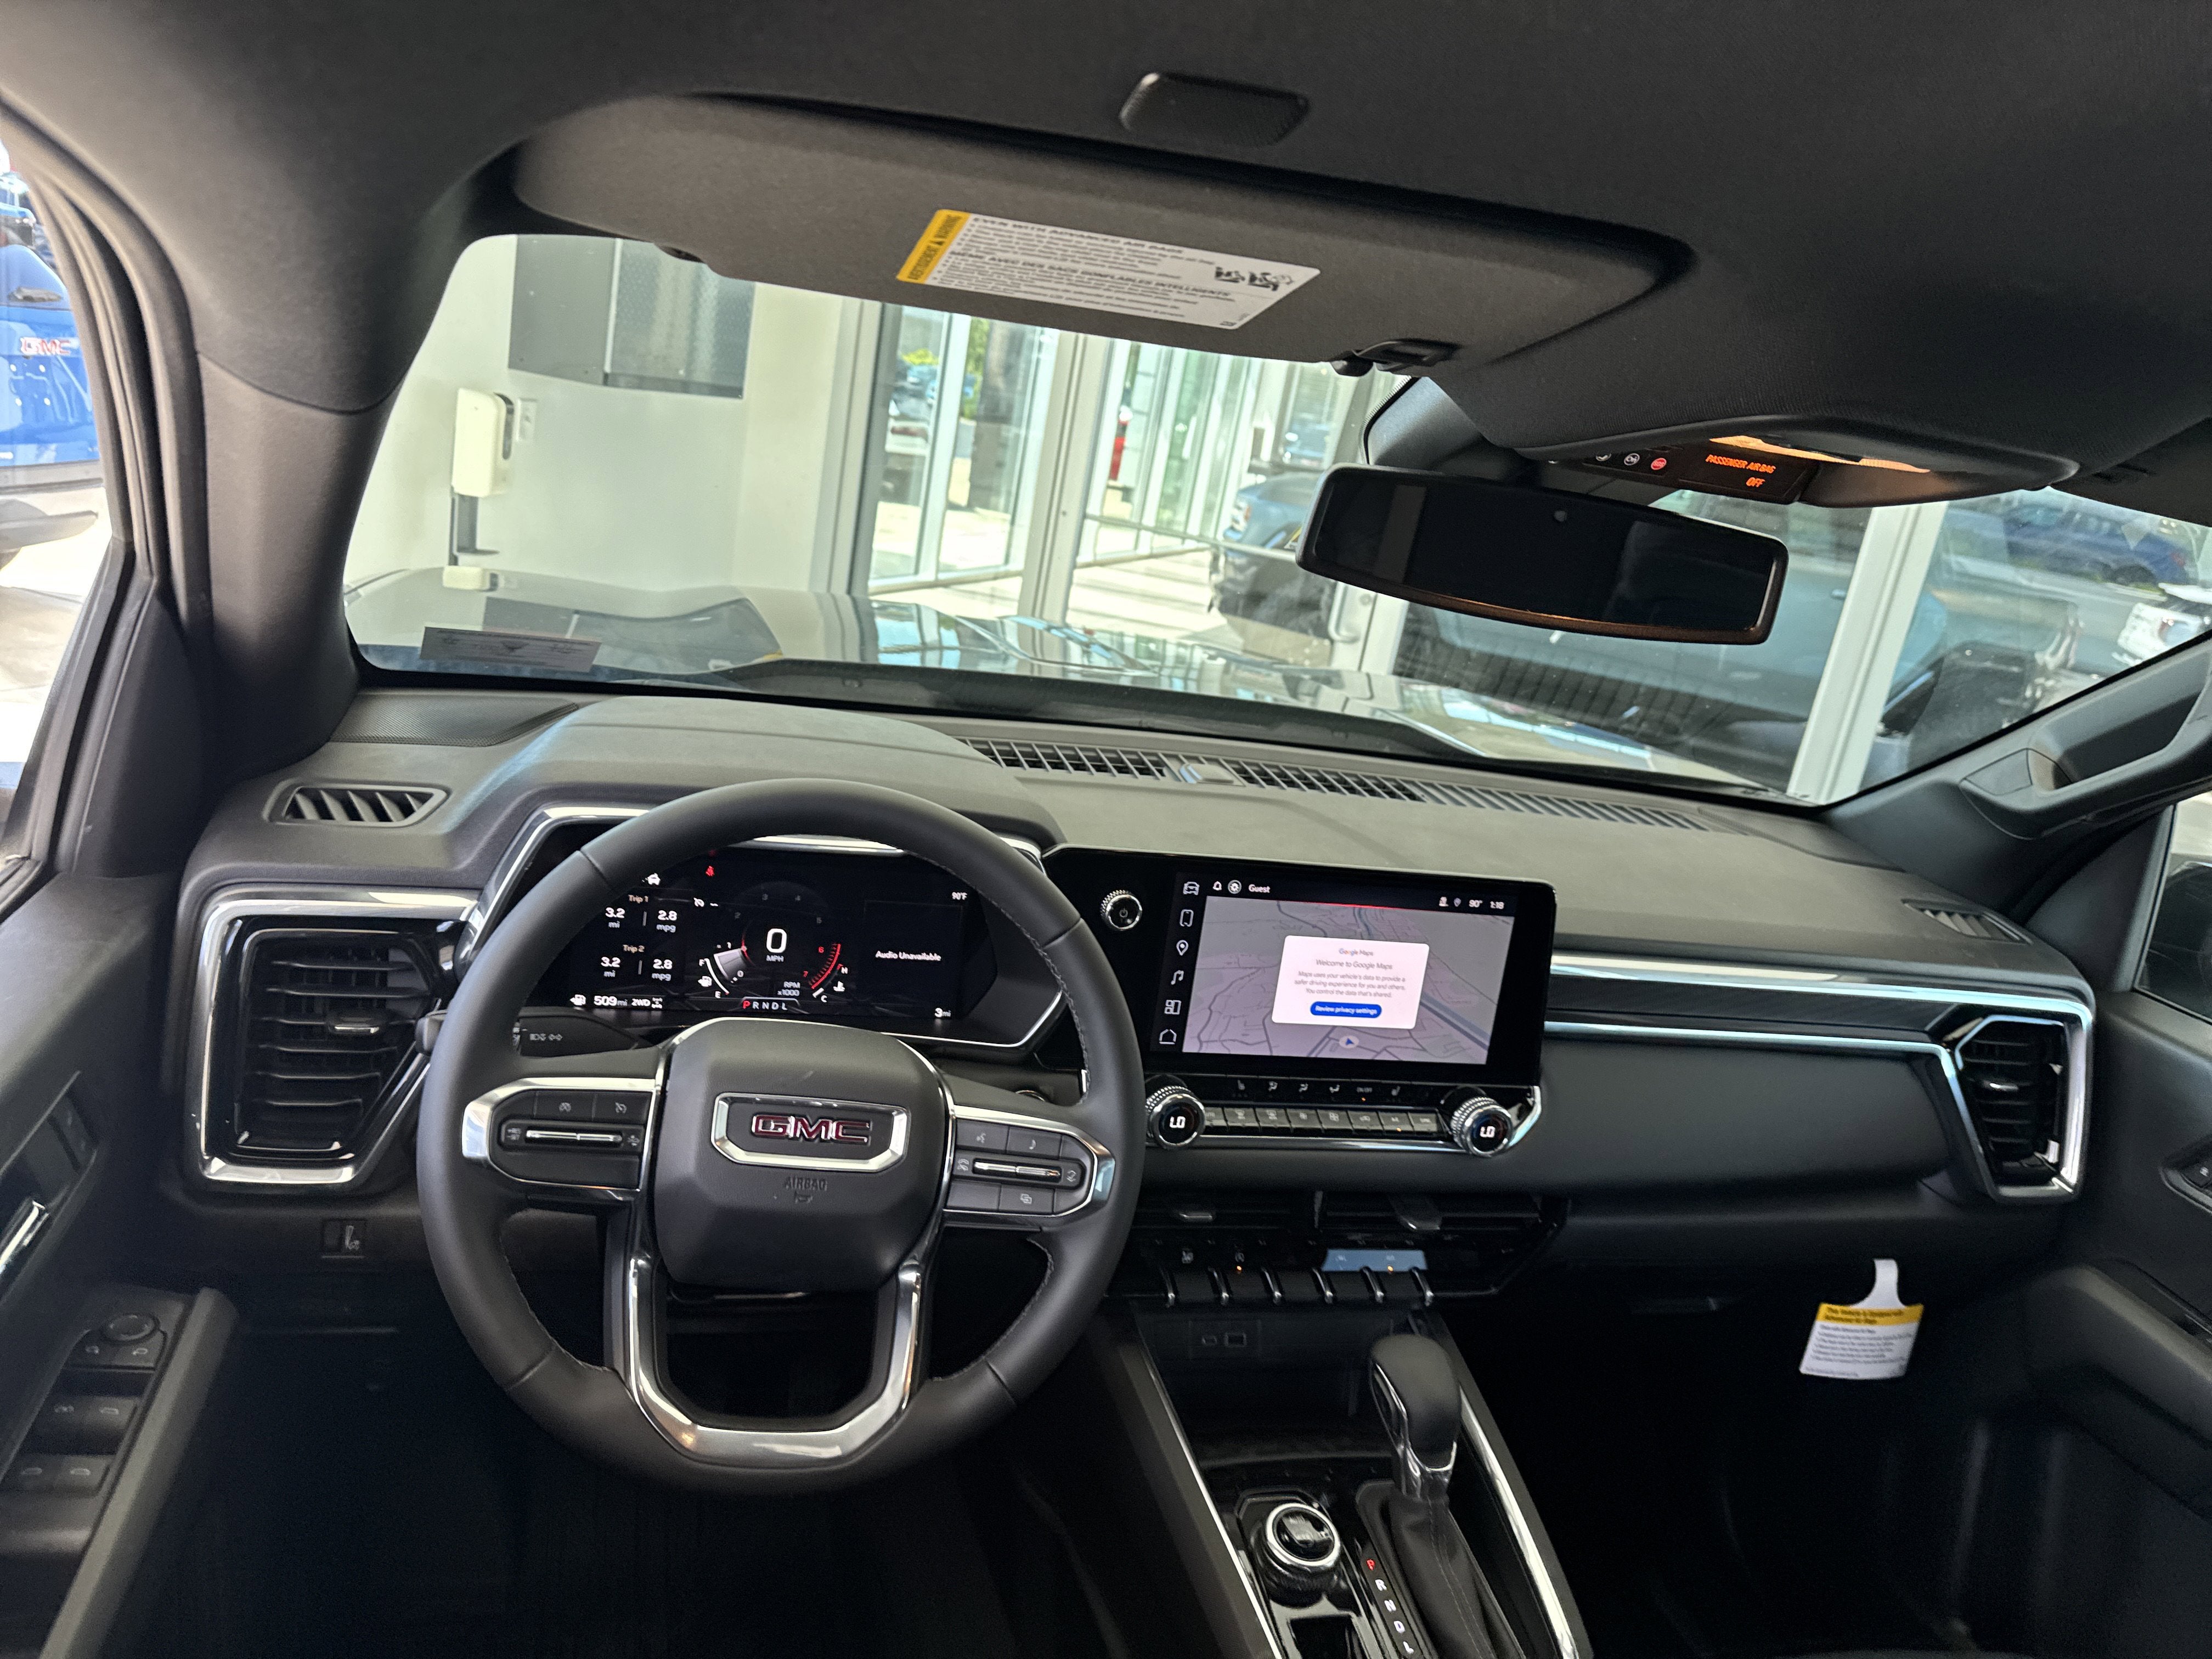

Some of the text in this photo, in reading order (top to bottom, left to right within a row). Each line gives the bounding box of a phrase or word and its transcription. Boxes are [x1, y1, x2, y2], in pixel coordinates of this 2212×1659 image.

[20, 337, 71, 356] GMC
[1705, 454, 1748, 469] PASSENGER
[1746, 477, 1765, 487] OFF
[1248, 884, 1271, 893] Guest
[628, 894, 644, 904] Trip
[605, 907, 678, 921] 3.2 2.8
[656, 924, 676, 933] mpg
[766, 928, 787, 953] 0
[623, 944, 638, 953] Trip
[601, 956, 673, 969] 3.2 2.8
[875, 951, 941, 961] Audio Unavailable
[1316, 959, 1345, 967] Welcome
[1353, 961, 1375, 970] Google
[1376, 962, 1393, 970] Maps
[652, 973, 672, 981] mpg
[631, 998, 651, 1007] 2WD
[742, 1000, 788, 1010] P R N D L
[1335, 1007, 1355, 1015] privacy
[1169, 1115, 1186, 1128] LO
[752, 1113, 872, 1144] GMC
[1480, 1125, 1496, 1138] LO
[785, 1176, 828, 1191] AIRBAG
[1366, 1559, 1375, 1570] P
[1375, 1578, 1387, 1591] R
[1384, 1599, 1397, 1612] N
[1393, 1620, 1406, 1633] D
[1403, 1641, 1414, 1654] L
